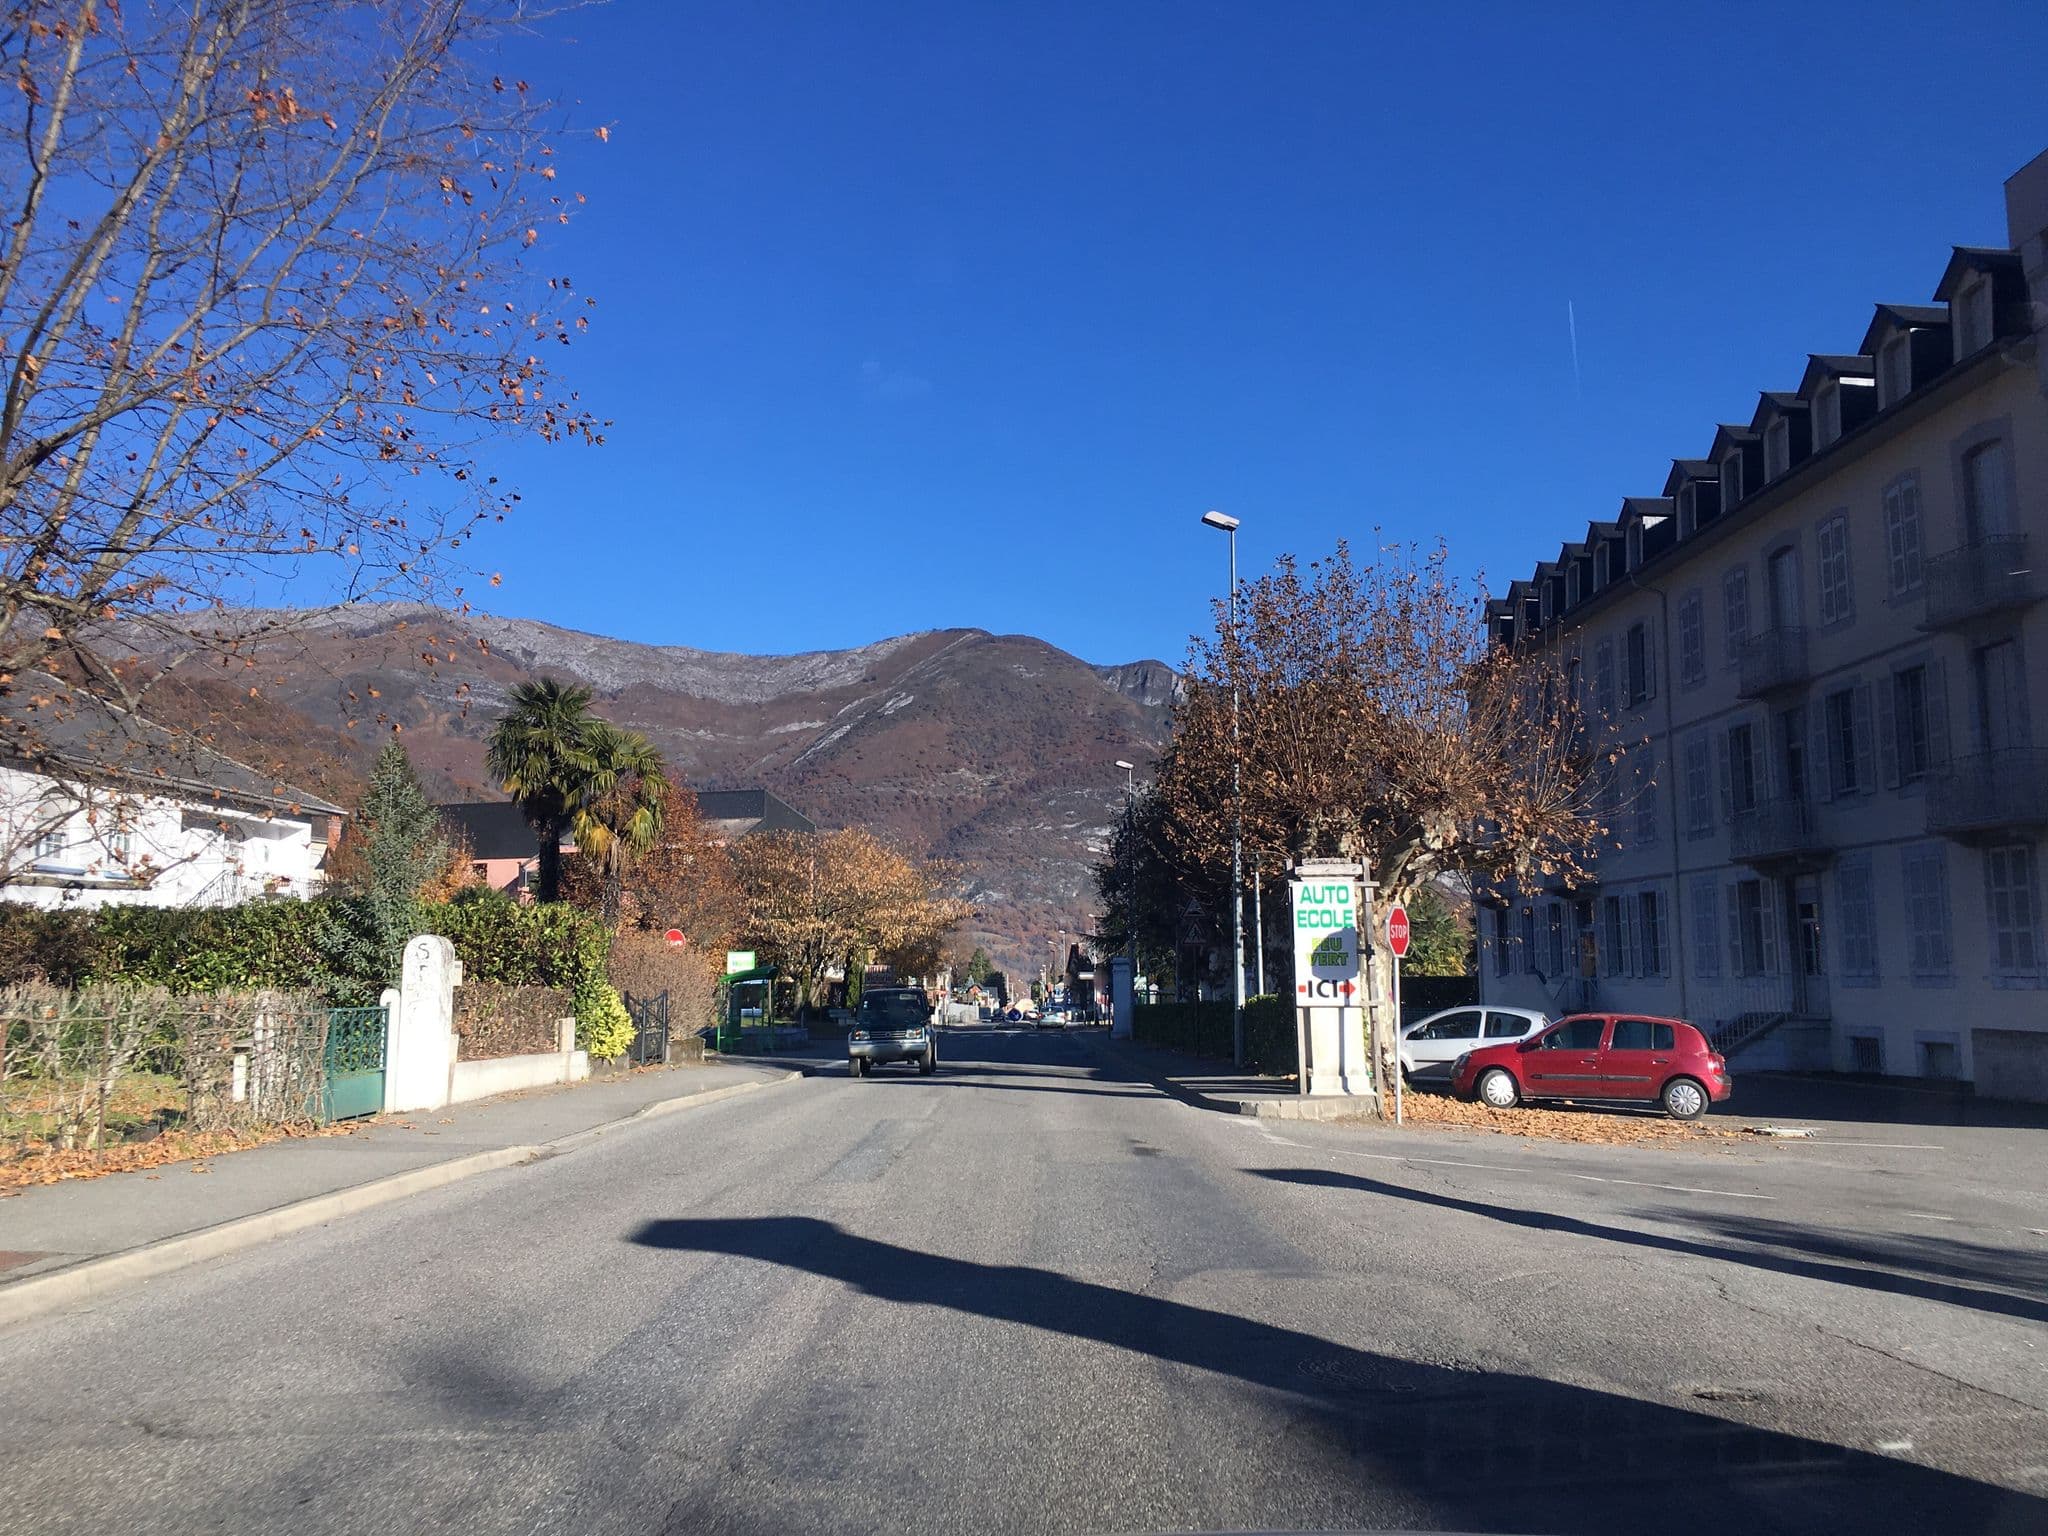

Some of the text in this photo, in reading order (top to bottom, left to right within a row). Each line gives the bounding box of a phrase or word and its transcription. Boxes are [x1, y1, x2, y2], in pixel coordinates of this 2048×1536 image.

[1300, 885, 1349, 904] AUTO
[1297, 909, 1353, 928] ECOLE
[1390, 924, 1407, 939] STOP
[1306, 952, 1349, 966] VERT
[1307, 980, 1338, 998] ICI
